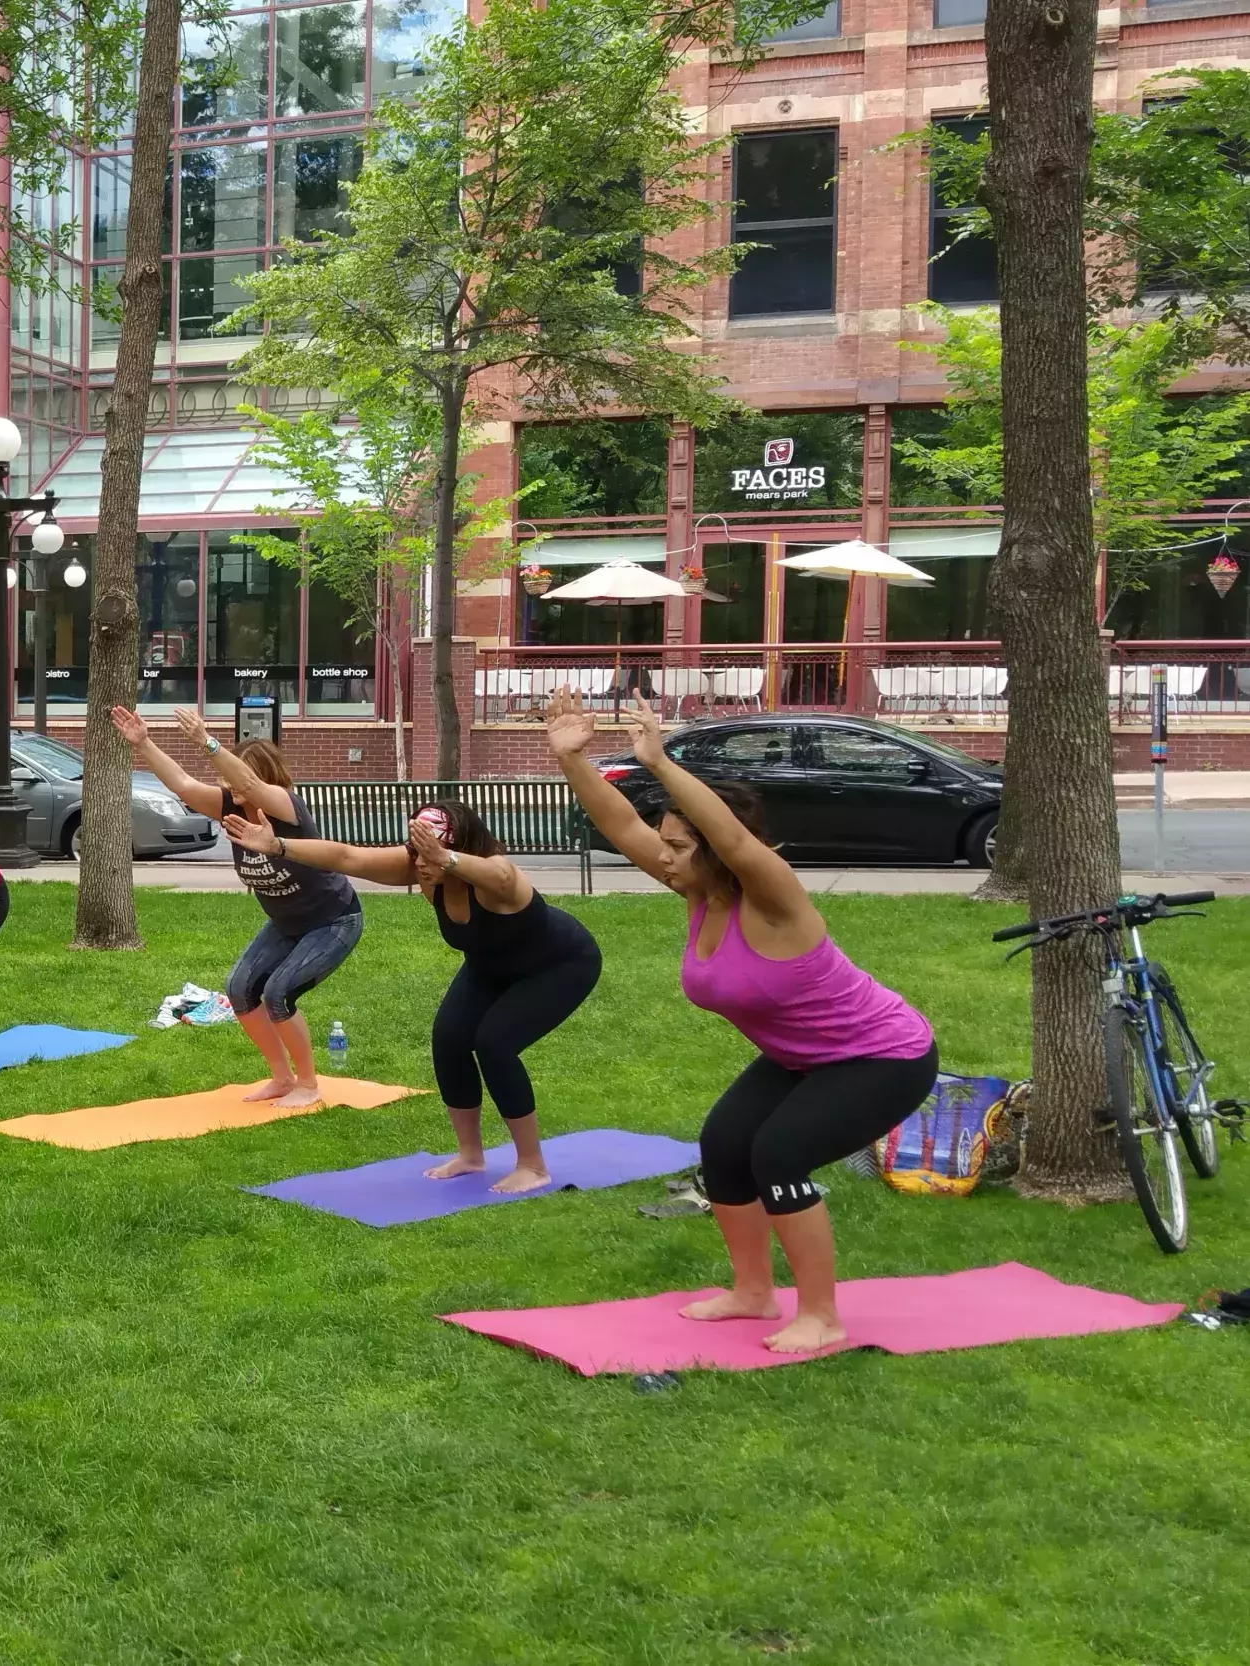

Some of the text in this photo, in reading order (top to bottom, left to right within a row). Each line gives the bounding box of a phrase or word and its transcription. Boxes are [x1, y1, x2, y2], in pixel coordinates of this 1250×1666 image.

[731, 467, 825, 490] FACES
[783, 490, 808, 499] park
[143, 669, 159, 678] bar
[234, 668, 268, 679] bakery
[312, 668, 368, 679] bottle shop
[240, 863, 275, 876] mardi
[771, 1181, 817, 1201] PIN
